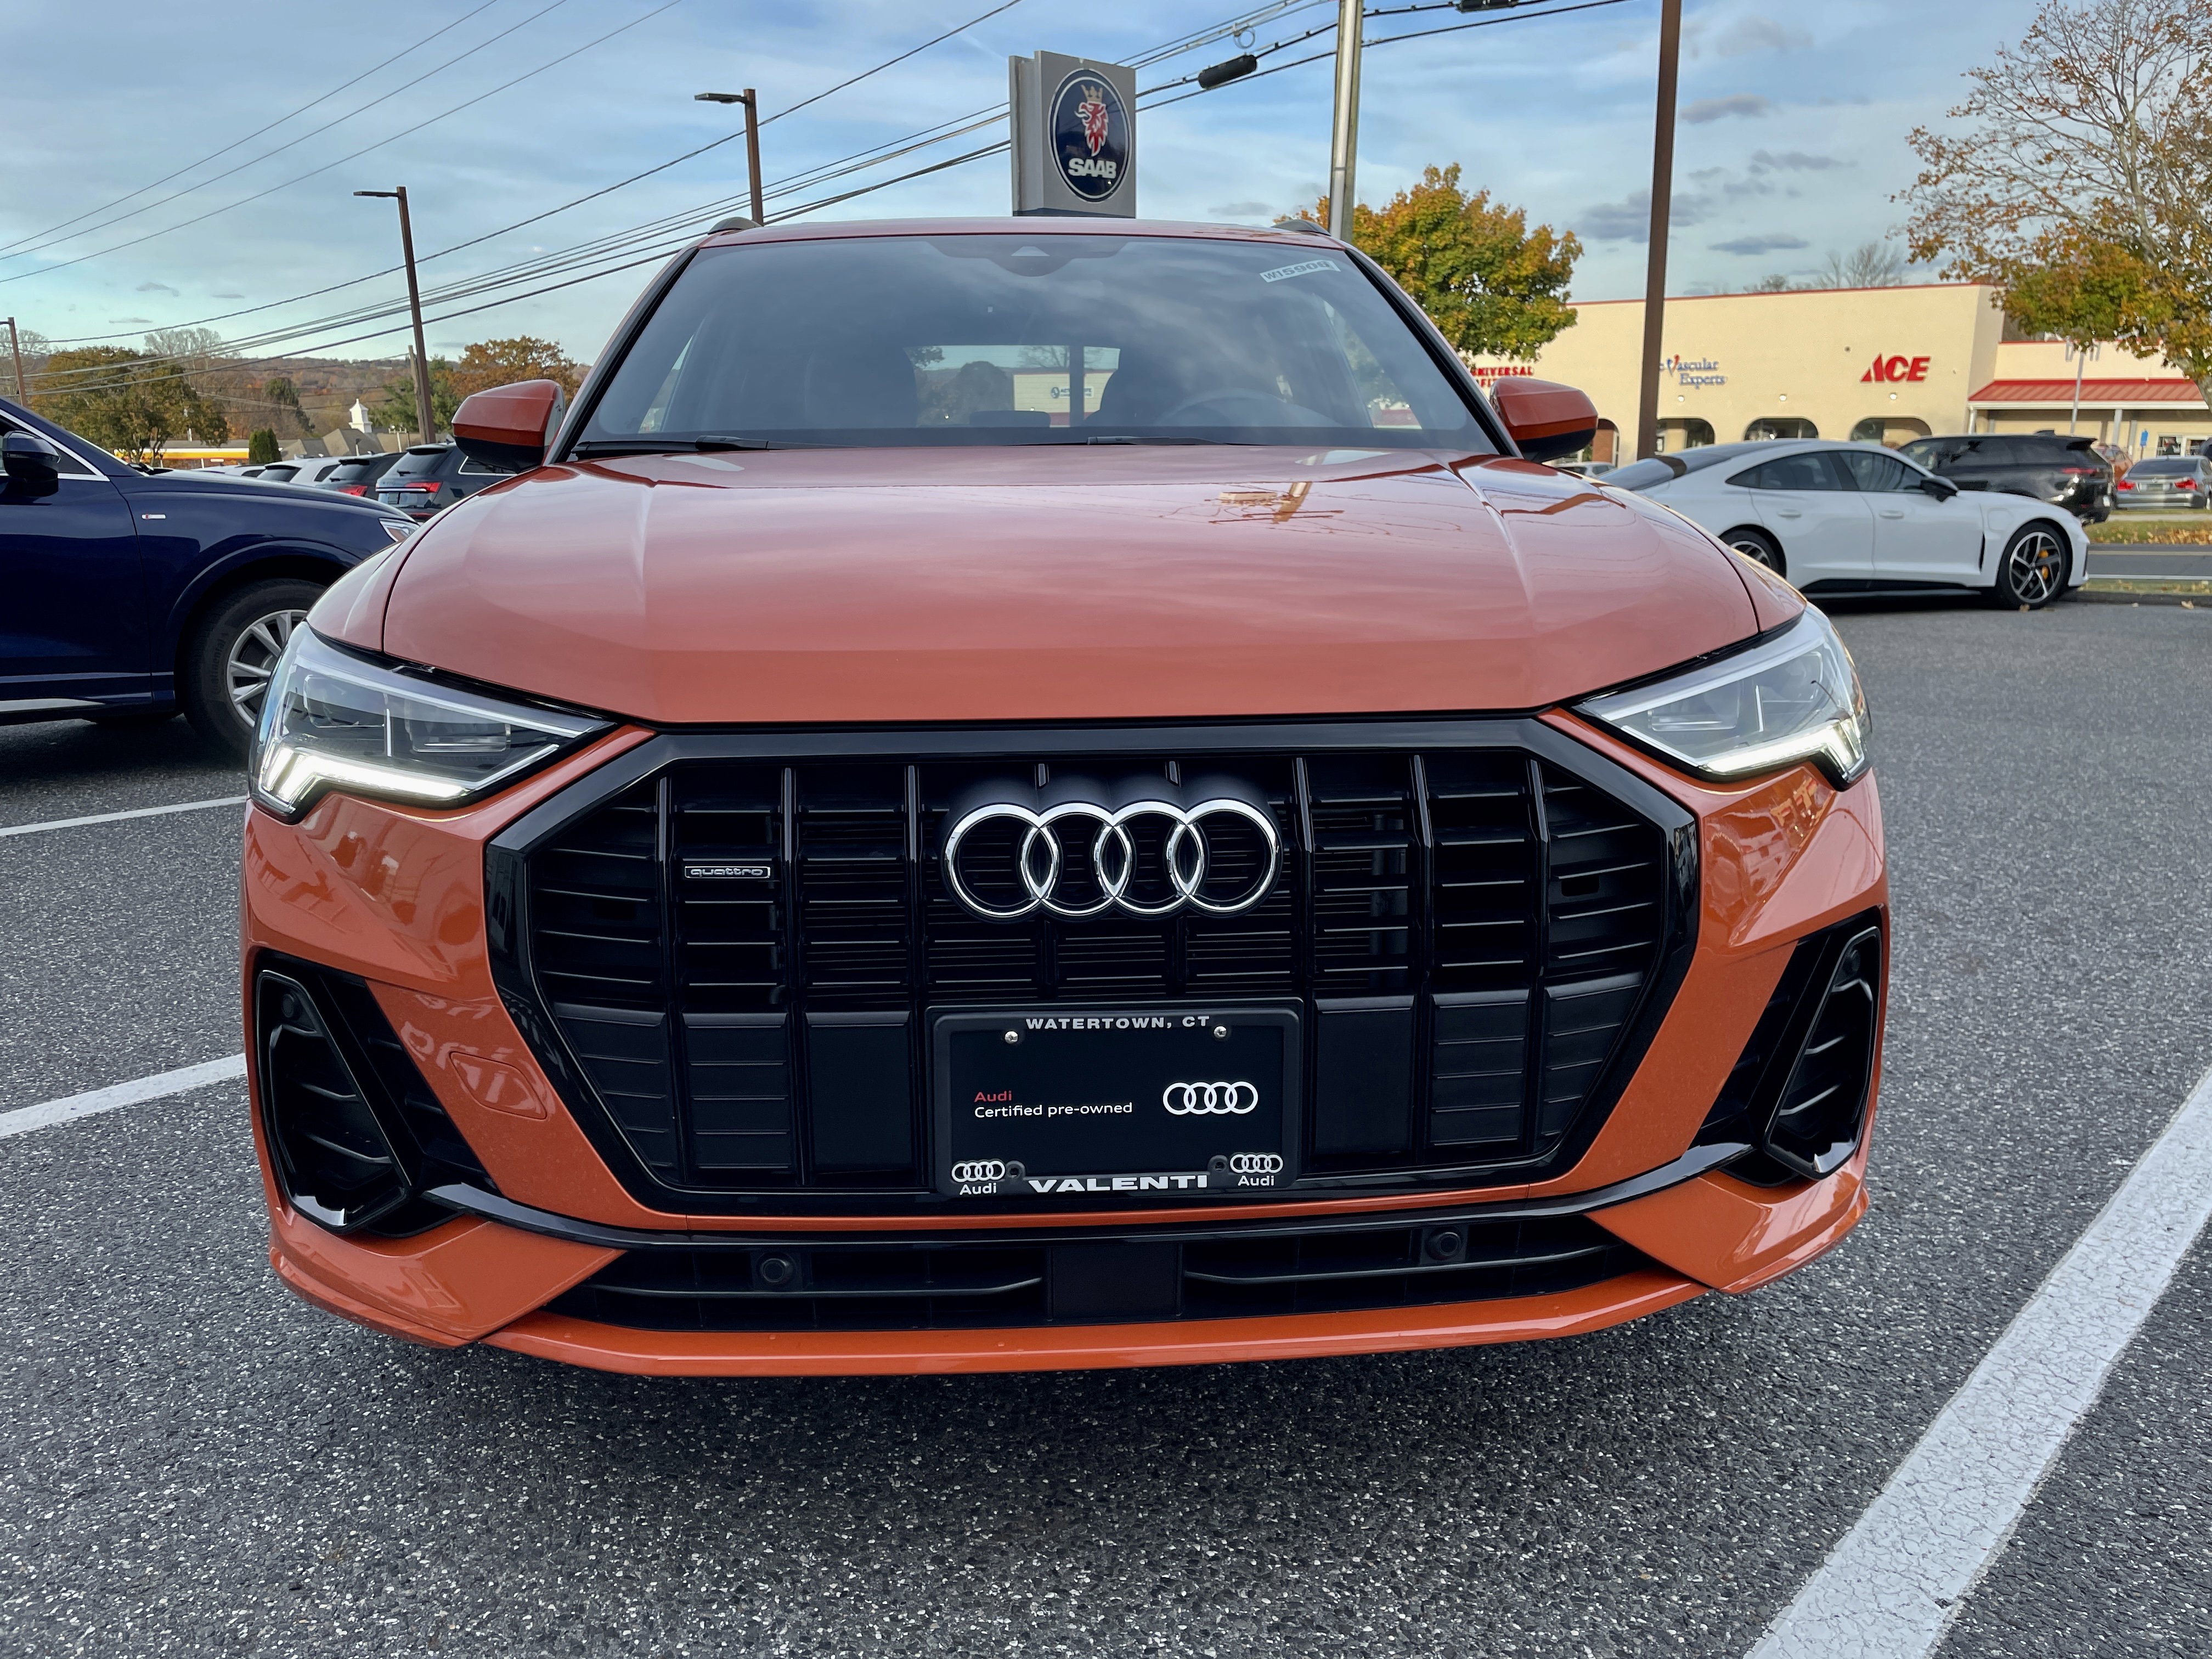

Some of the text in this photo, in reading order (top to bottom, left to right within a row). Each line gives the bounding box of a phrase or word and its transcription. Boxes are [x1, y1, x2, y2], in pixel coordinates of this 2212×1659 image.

[1068, 157, 1117, 179] SAAB
[1666, 354, 1719, 377] Vascular
[1860, 352, 1931, 382] ACE
[1679, 373, 1727, 390] Experts
[690, 867, 764, 877] quattro
[1026, 1015, 1210, 1029] WATERTOWN, CT
[974, 1091, 1012, 1102] Audi
[974, 1102, 1133, 1118] Certified pre-owned
[1028, 1175, 1207, 1193] VALENTI
[1238, 1175, 1275, 1186] Audi
[960, 1183, 997, 1195] Audi
